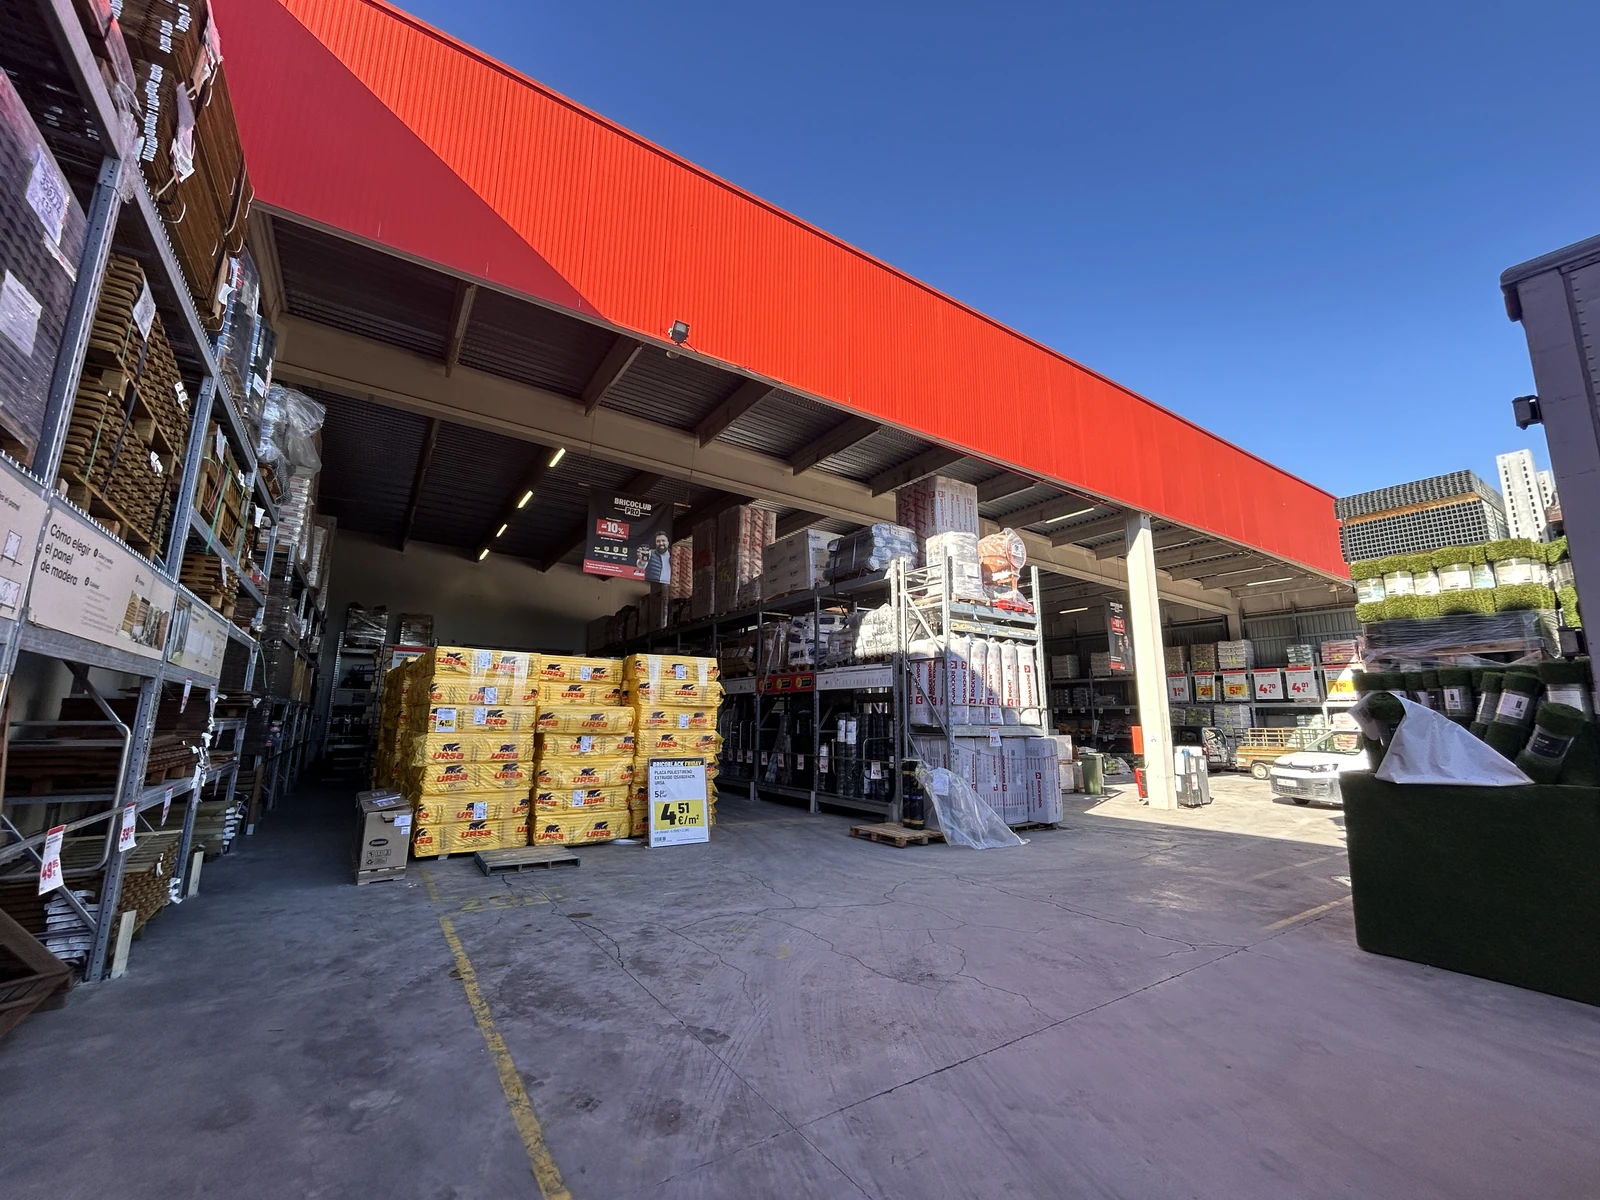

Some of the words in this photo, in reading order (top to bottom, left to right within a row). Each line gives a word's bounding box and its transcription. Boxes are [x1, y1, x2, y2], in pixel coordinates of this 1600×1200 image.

[614, 497, 652, 511] BRICOCLUB
[626, 507, 640, 516] PRO
[50, 523, 72, 546] Cómo
[71, 536, 92, 556] elegir
[44, 543, 52, 553] el
[52, 547, 74, 565] panel
[40, 560, 50, 573] de
[50, 565, 78, 586] madera
[1259, 683, 1268, 693] 4
[1291, 682, 1301, 693] 4
[1333, 682, 1339, 692] 1
[661, 803, 677, 825] 4
[678, 803, 690, 813] 51
[41, 861, 52, 880] 49
